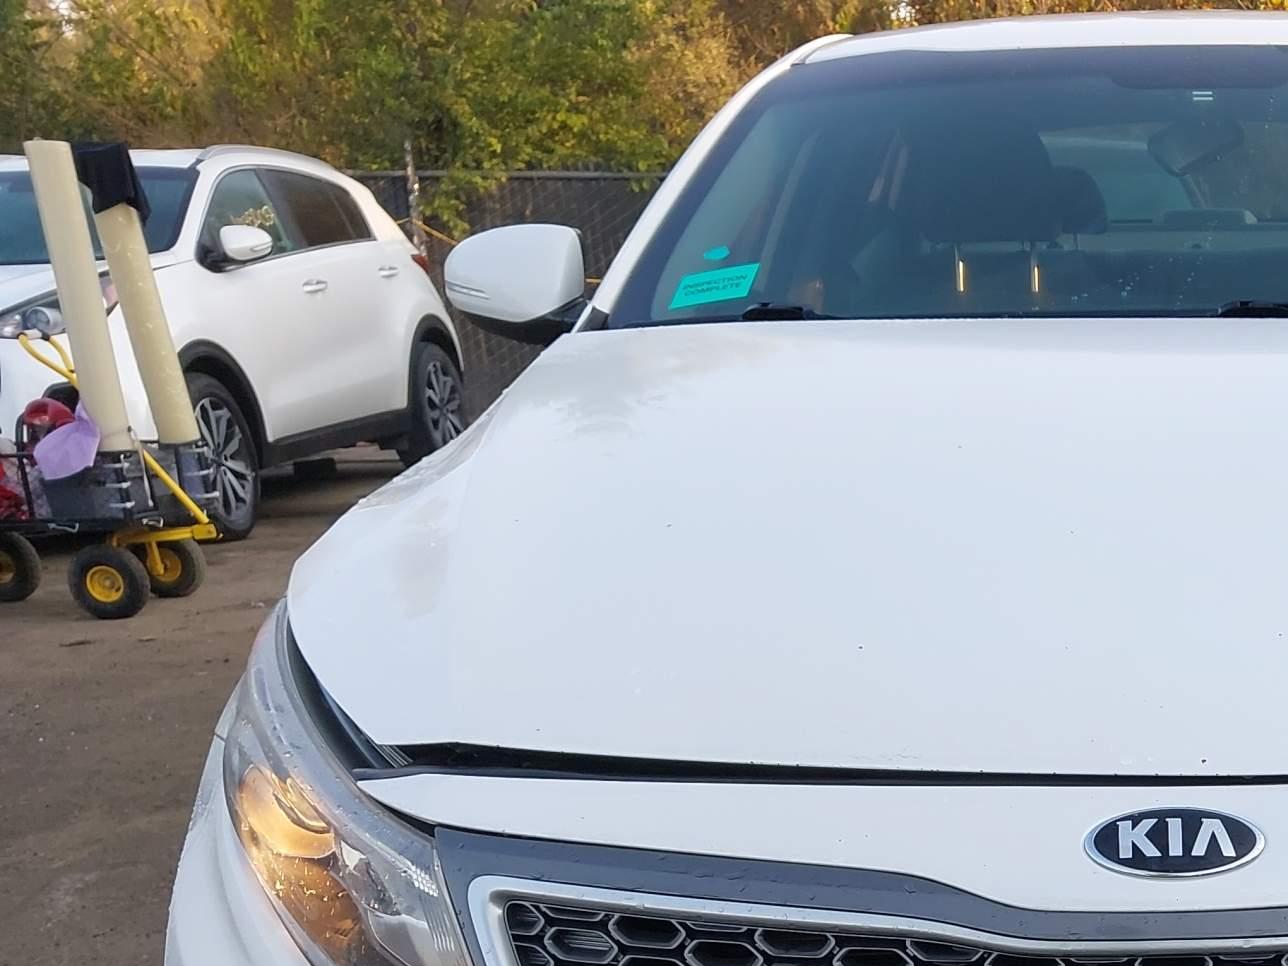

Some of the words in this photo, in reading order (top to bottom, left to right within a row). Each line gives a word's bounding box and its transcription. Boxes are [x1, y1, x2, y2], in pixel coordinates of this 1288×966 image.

[683, 273, 748, 290] INSPECTION
[684, 282, 741, 297] COMPLETE
[1115, 817, 1238, 860] KIA
